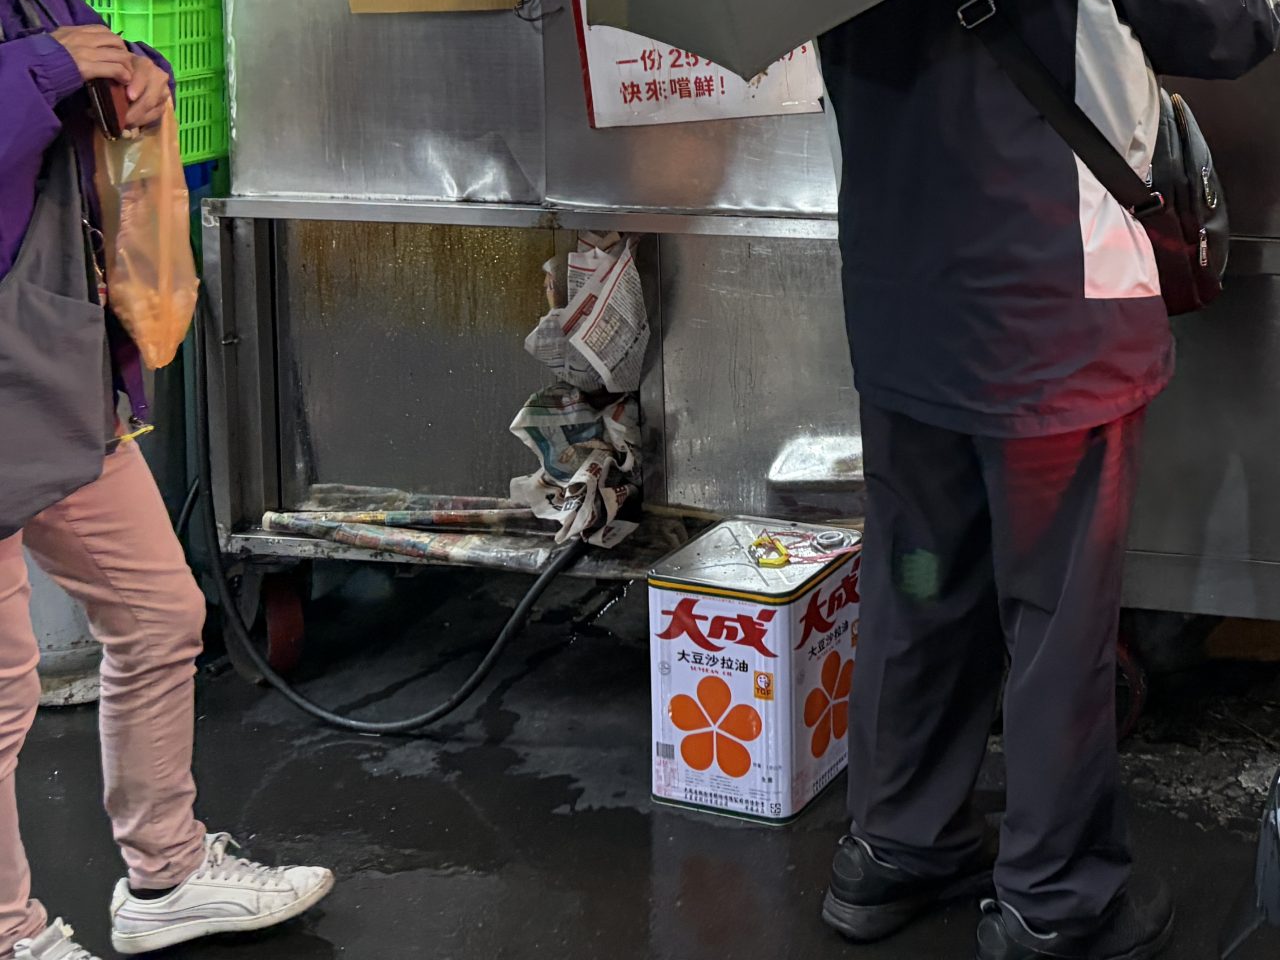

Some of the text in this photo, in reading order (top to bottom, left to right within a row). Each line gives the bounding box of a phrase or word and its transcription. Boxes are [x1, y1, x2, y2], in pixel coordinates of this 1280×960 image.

[655, 597, 779, 658] 大成
[794, 556, 861, 650] 大成
[677, 649, 749, 673] 大豆沙拉油
[808, 620, 849, 661] 大豆沙拉油
